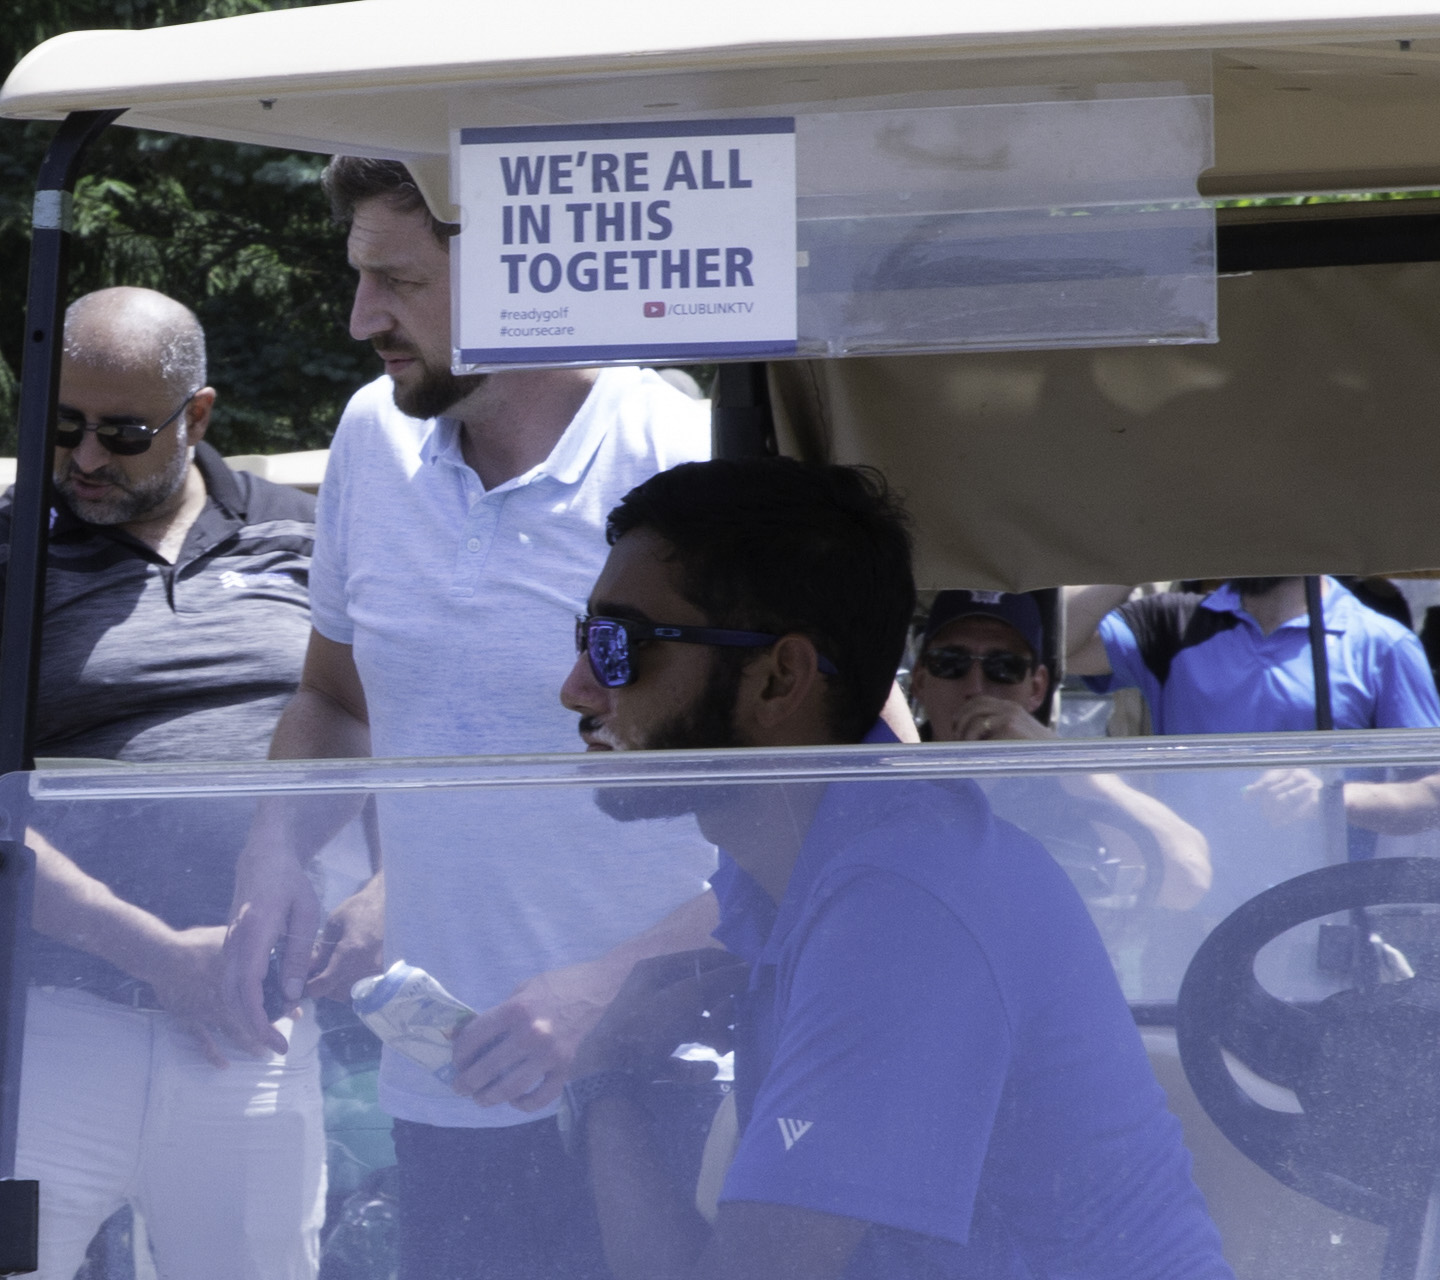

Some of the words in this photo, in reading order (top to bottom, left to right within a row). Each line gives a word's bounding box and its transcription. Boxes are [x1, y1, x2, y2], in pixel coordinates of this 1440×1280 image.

[500, 151, 649, 196] WE'RE
[664, 149, 752, 191] ALL
[502, 204, 550, 244] IN
[566, 200, 673, 242] THIS
[500, 247, 754, 293] TOGETHER
[500, 307, 569, 322] #readygolf
[668, 302, 754, 317] /CLUBLINKTV
[500, 324, 574, 337] #coursecare
